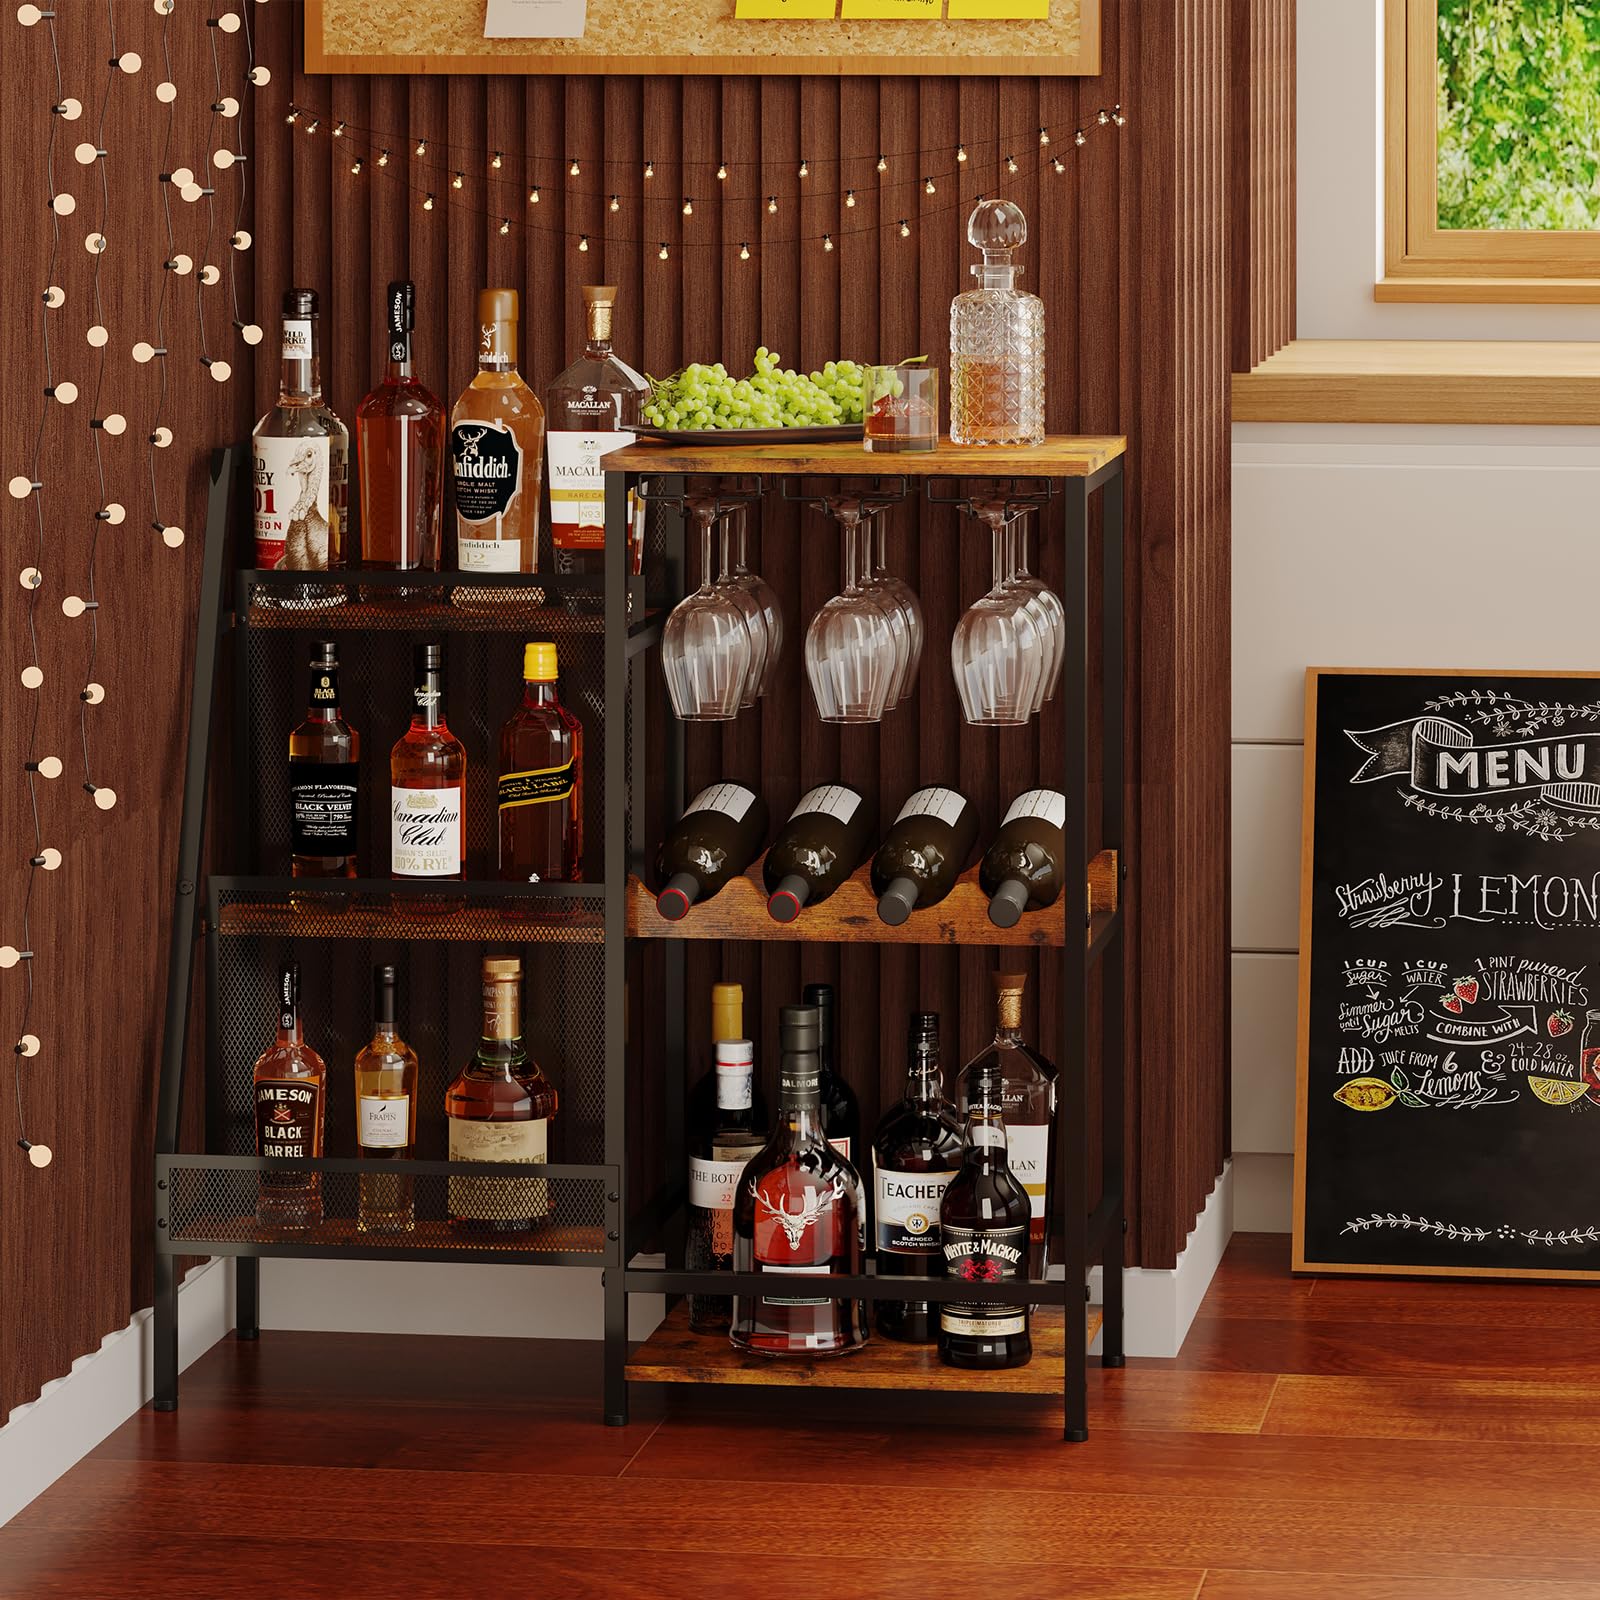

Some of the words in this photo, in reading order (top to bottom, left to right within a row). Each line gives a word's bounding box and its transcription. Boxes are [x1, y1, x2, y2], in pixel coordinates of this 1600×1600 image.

[393, 290, 403, 332] JAMESON
[567, 401, 612, 409] MACALLAN
[1436, 743, 1586, 790] MENU
[533, 778, 569, 789] LABEL
[295, 803, 325, 811] BLACK
[326, 803, 353, 811] VELVET
[392, 800, 459, 824] Canadian
[398, 824, 447, 846] Club
[423, 857, 448, 871] RYE
[1356, 958, 1388, 969] CUP
[1418, 960, 1449, 971] CUP
[1489, 955, 1516, 969] PINT
[1517, 959, 1588, 987] pureed
[1405, 971, 1443, 985] WATER
[1481, 970, 1589, 1007] STRAWBERRIES
[1338, 998, 1395, 1019] Simmer
[1340, 1017, 1363, 1031] until
[1362, 1001, 1425, 1044] Sugar
[1394, 1024, 1420, 1037] MELTS
[1436, 1021, 1489, 1037] COMBINE
[1492, 1018, 1522, 1034] WITH
[1336, 1047, 1376, 1075] ADD
[1379, 1050, 1405, 1067] JUICE
[1409, 1051, 1439, 1069] FROM
[1442, 1051, 1459, 1072] 6
[1511, 1057, 1537, 1072] COLD
[1540, 1060, 1575, 1078] WATER
[782, 1078, 818, 1088] DALMORE
[1412, 1068, 1489, 1097] Lemons
[258, 1088, 313, 1104] JAMESON
[265, 1125, 303, 1139] BLACK
[264, 1144, 304, 1158] BARREL
[691, 1169, 708, 1182] THE
[721, 1194, 732, 1202] 22
[943, 1241, 973, 1261] WHYTE
[973, 1241, 980, 1252] &
[981, 1239, 1022, 1264] MACKAY
